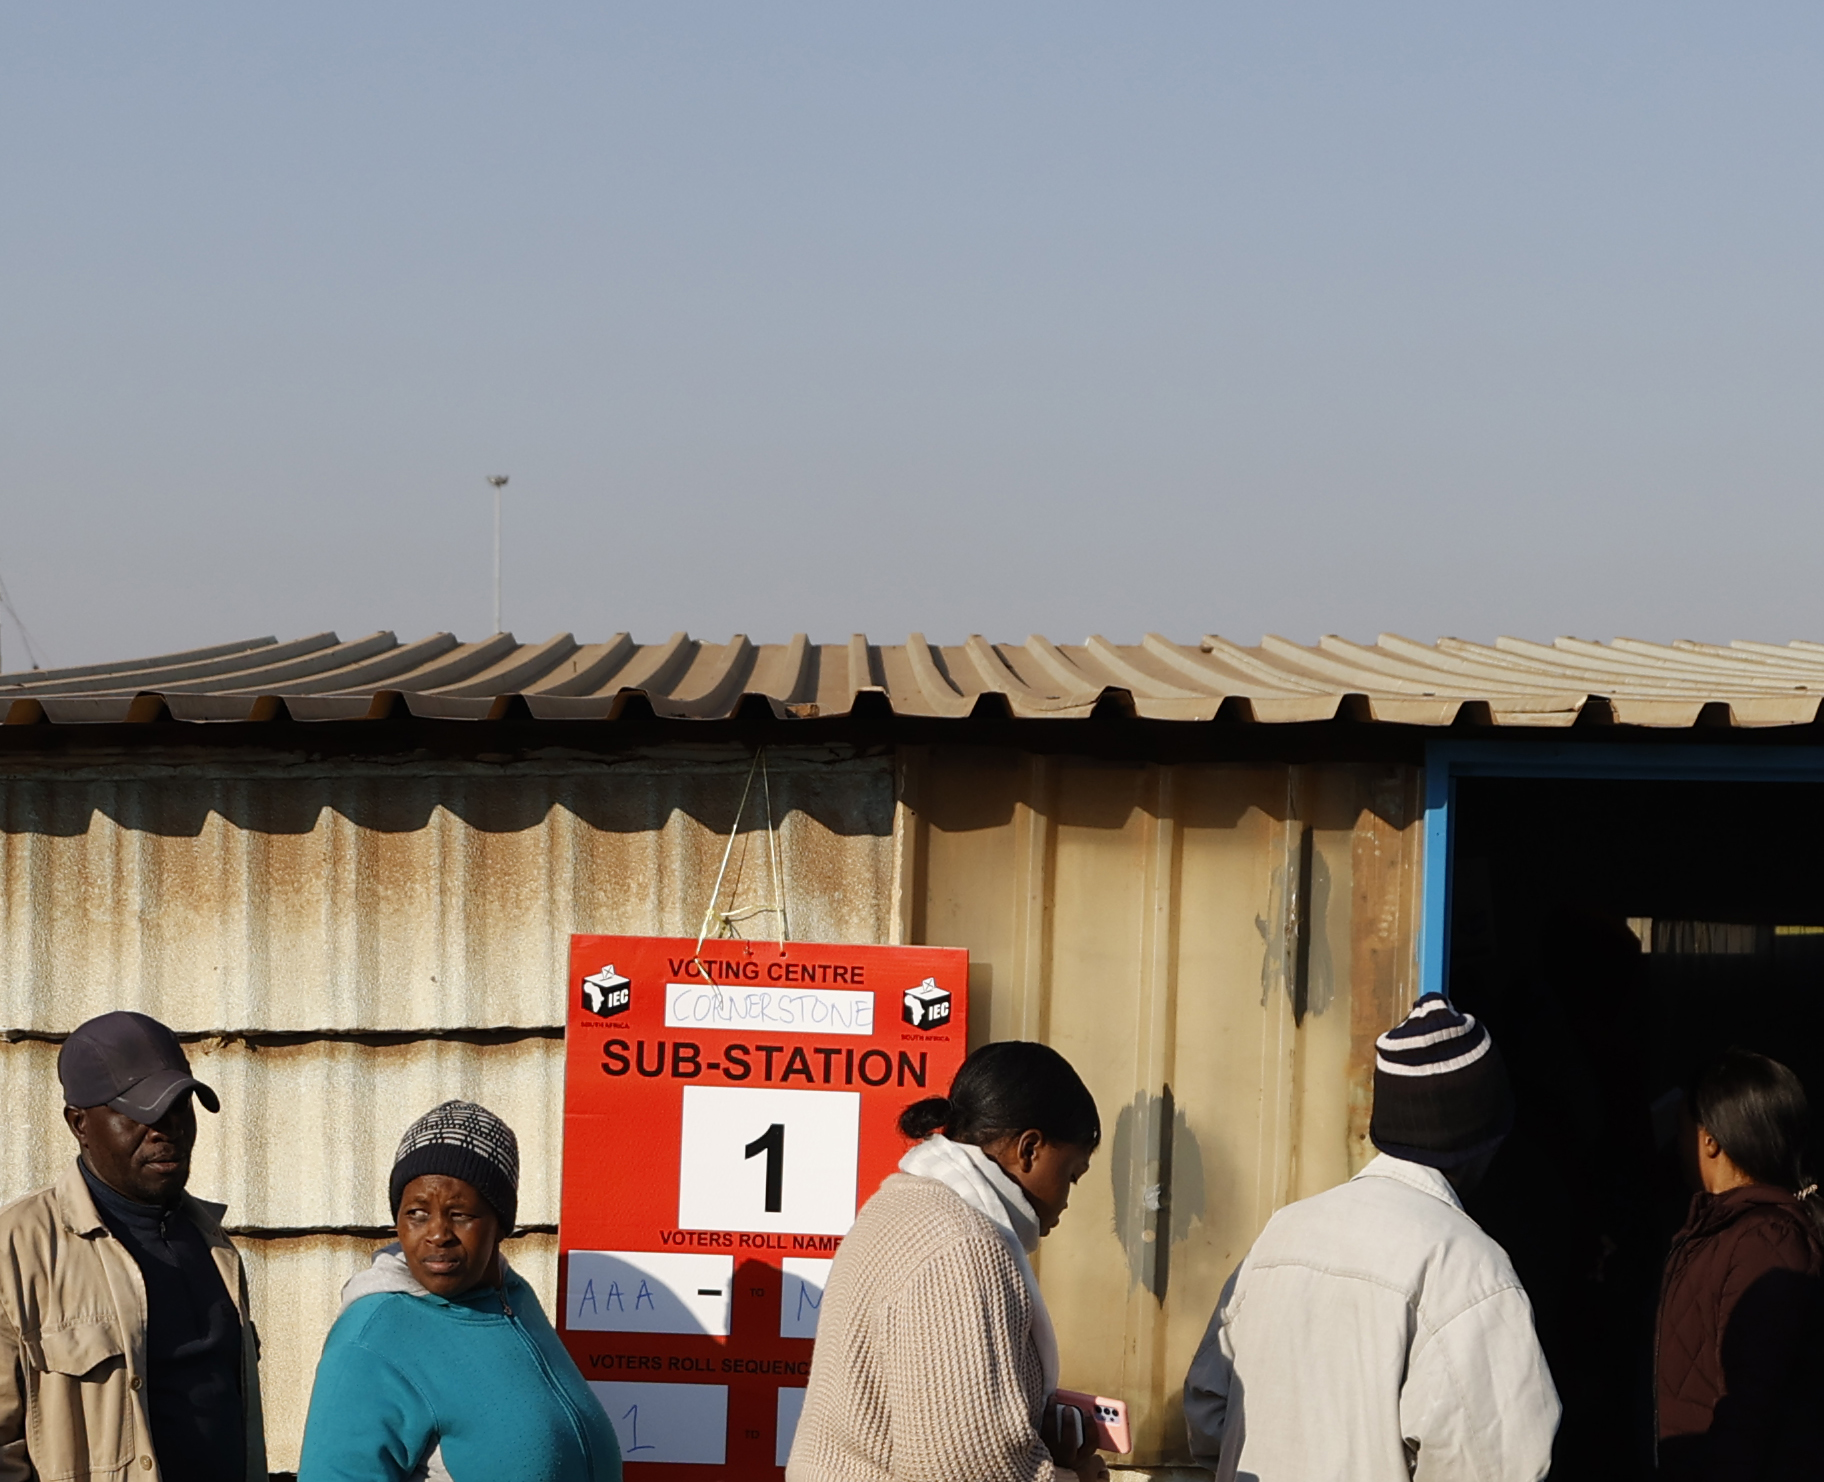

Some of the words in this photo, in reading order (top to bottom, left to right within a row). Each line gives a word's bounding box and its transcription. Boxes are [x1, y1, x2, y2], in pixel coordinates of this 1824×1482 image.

[667, 957, 760, 982] VOTING
[767, 961, 865, 985] CENTRE
[608, 988, 629, 1008] IEC
[671, 989, 873, 1028] CORNERSTONE
[928, 1001, 950, 1021] IEC
[600, 1038, 928, 1088] SUB-STATION
[743, 1123, 785, 1213] 1
[659, 1230, 733, 1248] VOTERS
[739, 1233, 787, 1250] ROLL
[589, 1353, 662, 1371] VOTERS
[668, 1356, 716, 1372] ROLL
[721, 1357, 810, 1376] SEQUENC
[622, 1404, 655, 1453] 1
